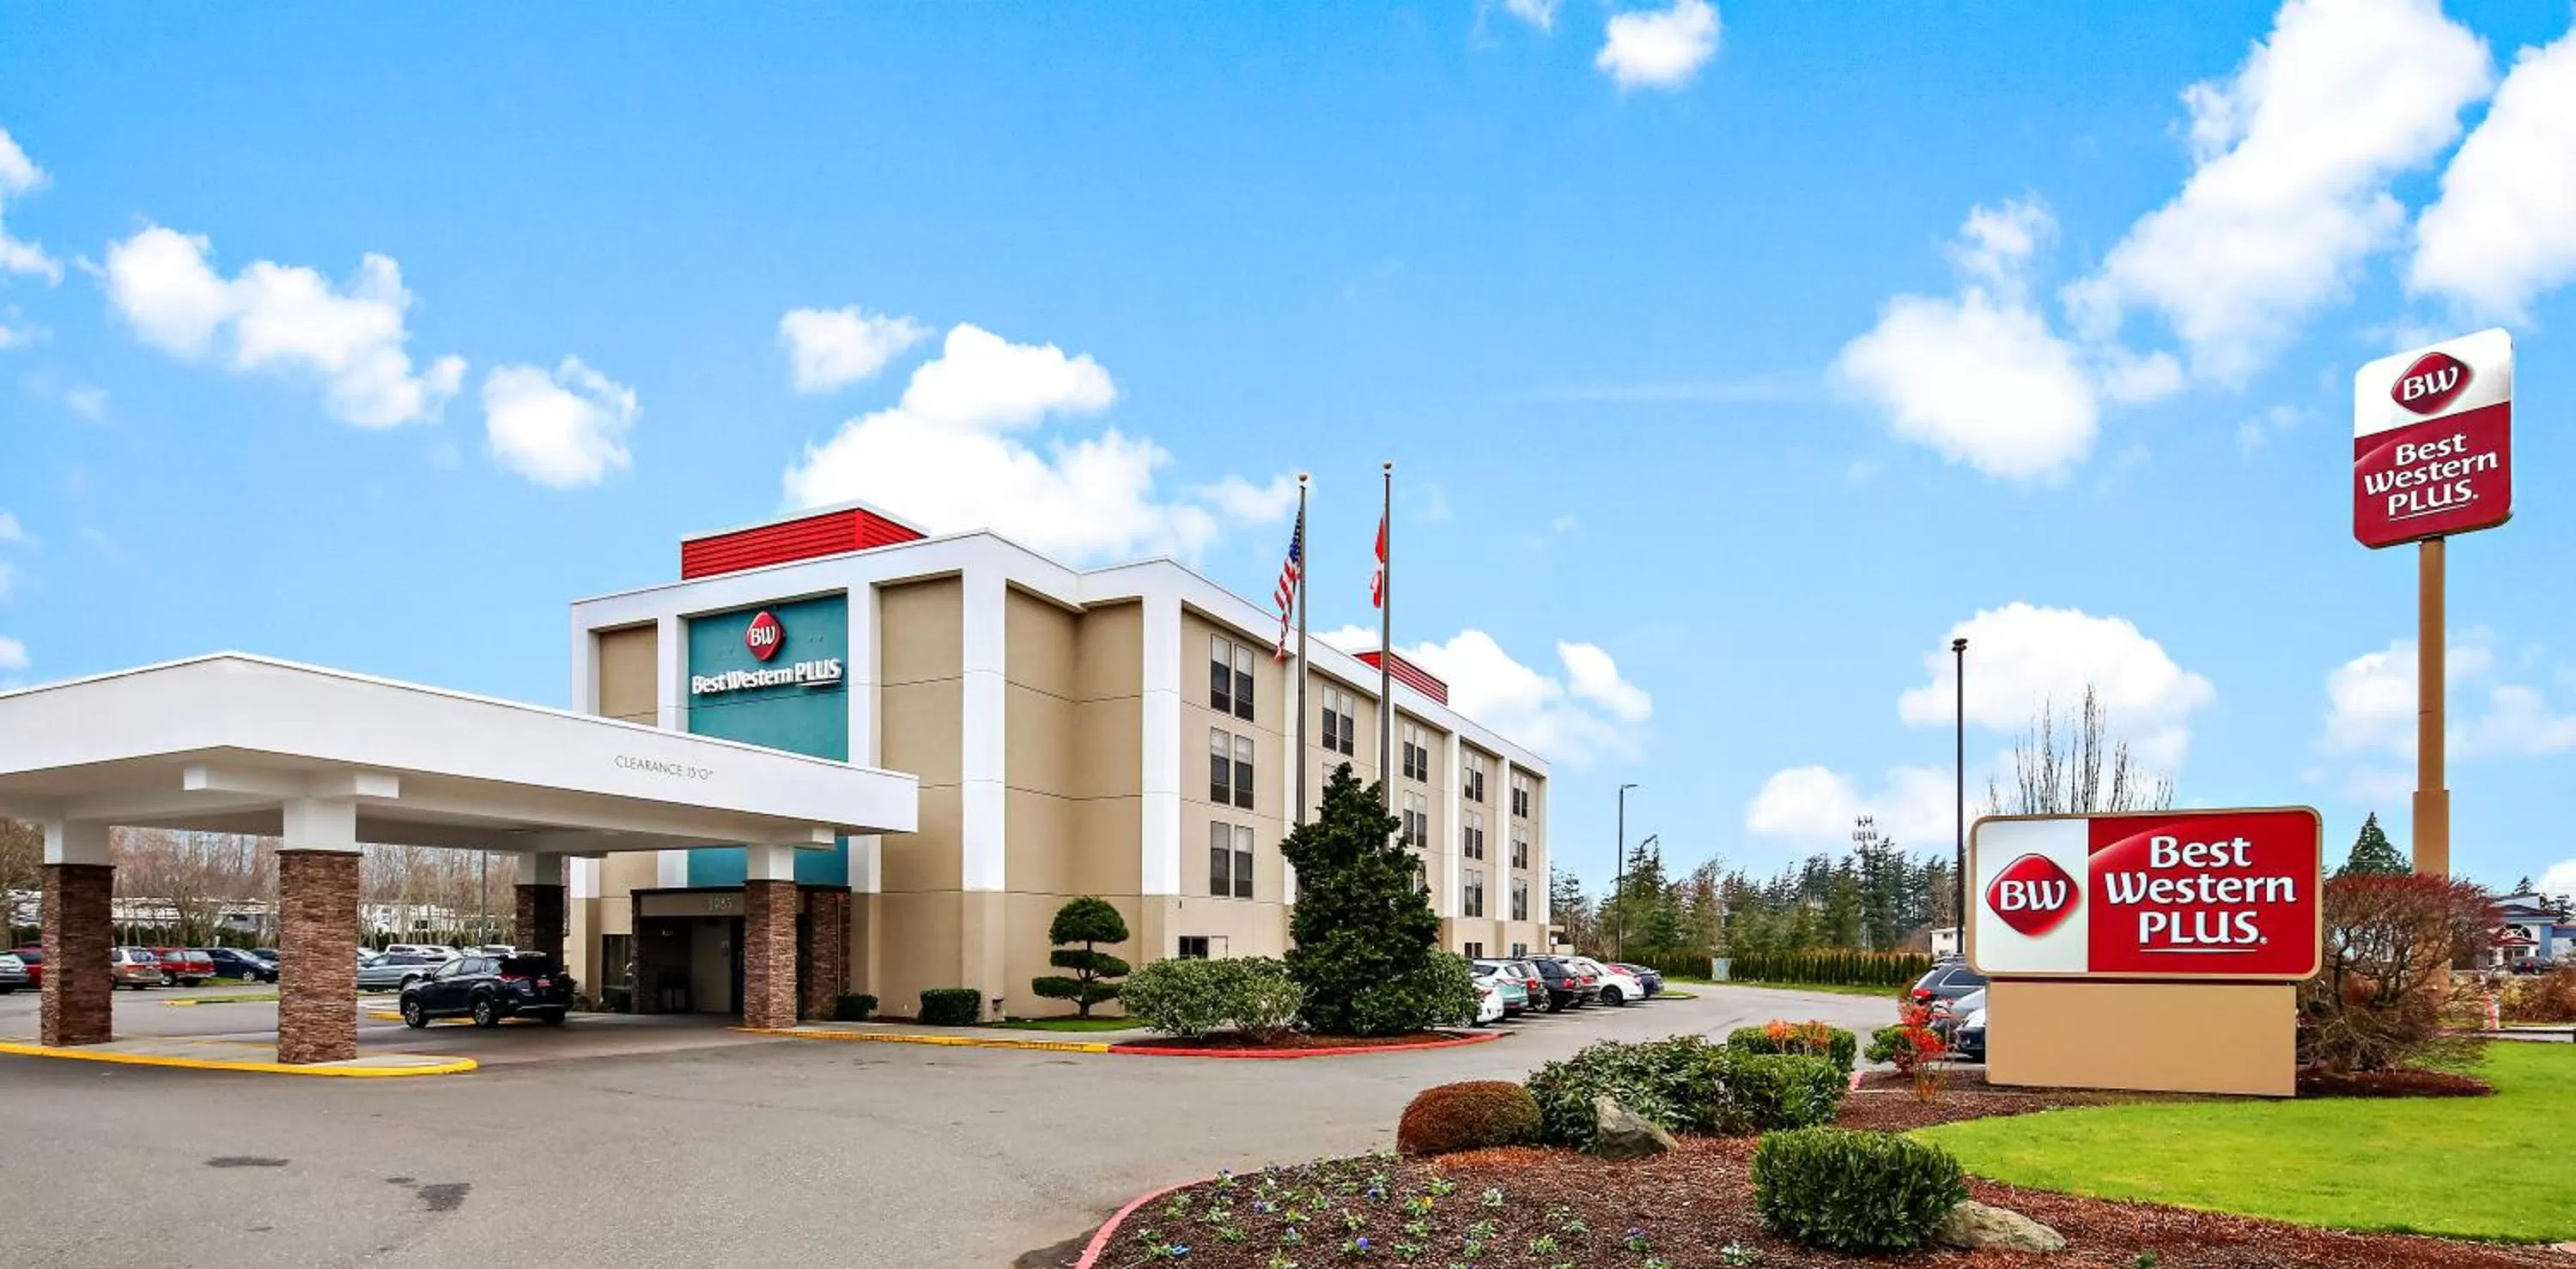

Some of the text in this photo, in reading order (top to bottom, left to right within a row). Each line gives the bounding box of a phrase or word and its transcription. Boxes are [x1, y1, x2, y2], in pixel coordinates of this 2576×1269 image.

[2403, 367, 2458, 401] BW
[2396, 433, 2467, 466] Best
[2364, 451, 2498, 495] Western
[750, 626, 775, 647] BW
[692, 658, 842, 695] Best Western PLUS
[614, 755, 683, 776] CLEARANCE
[2149, 835, 2252, 868] Best
[1999, 879, 2068, 911] BW
[2105, 872, 2297, 904] Western
